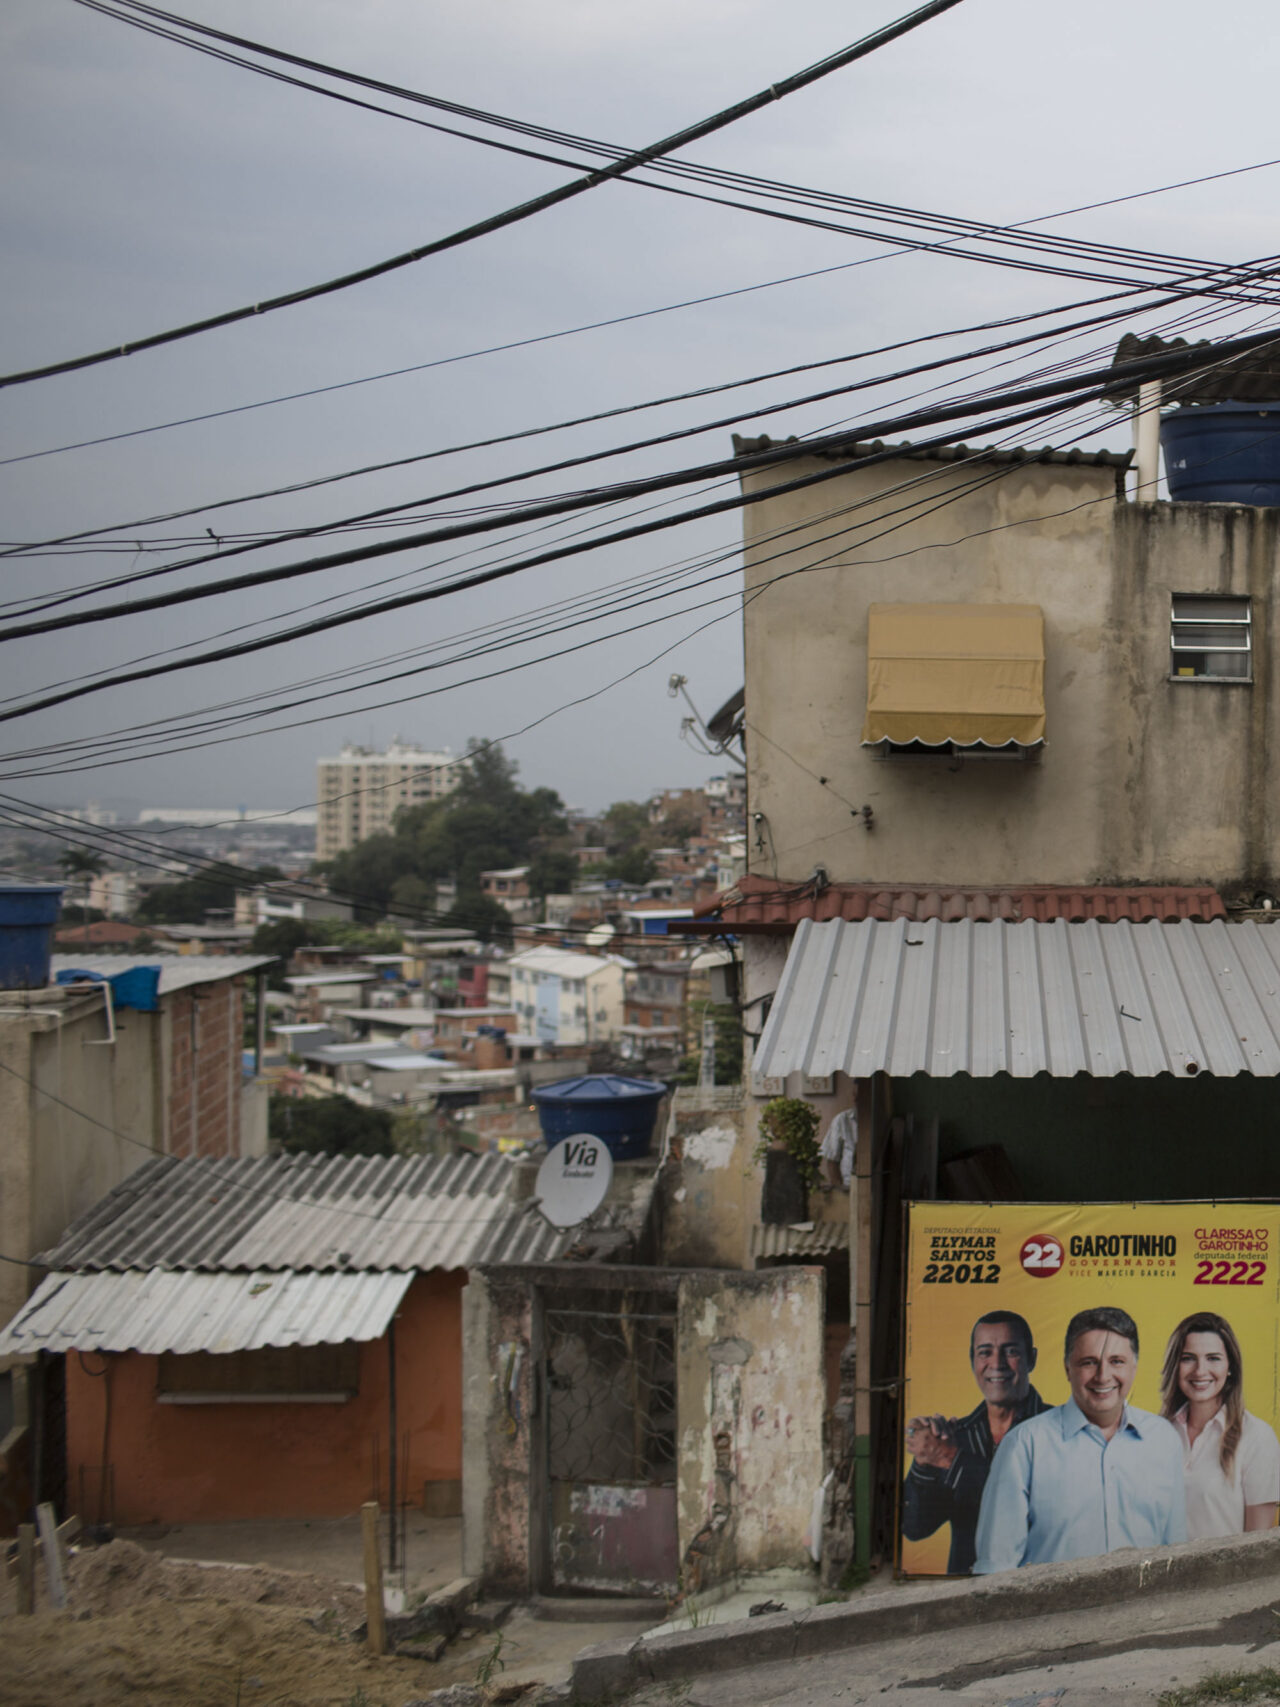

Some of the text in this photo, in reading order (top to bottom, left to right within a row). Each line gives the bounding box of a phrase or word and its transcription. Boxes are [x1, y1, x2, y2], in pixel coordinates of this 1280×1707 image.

[564, 1140, 598, 1167] Via
[1194, 1228, 1254, 1240] CLARISSA
[929, 1236, 996, 1248] ELYMAR
[1070, 1234, 1177, 1257] GAROTINHO
[1198, 1240, 1268, 1252] GAROTINHO
[929, 1249, 996, 1262] SANTOS
[1022, 1244, 1062, 1268] 22
[1193, 1252, 1268, 1261] deputada federal
[1069, 1258, 1176, 1267] GOVERNADOR
[922, 1263, 1001, 1284] 22012
[1193, 1260, 1267, 1285] 2222
